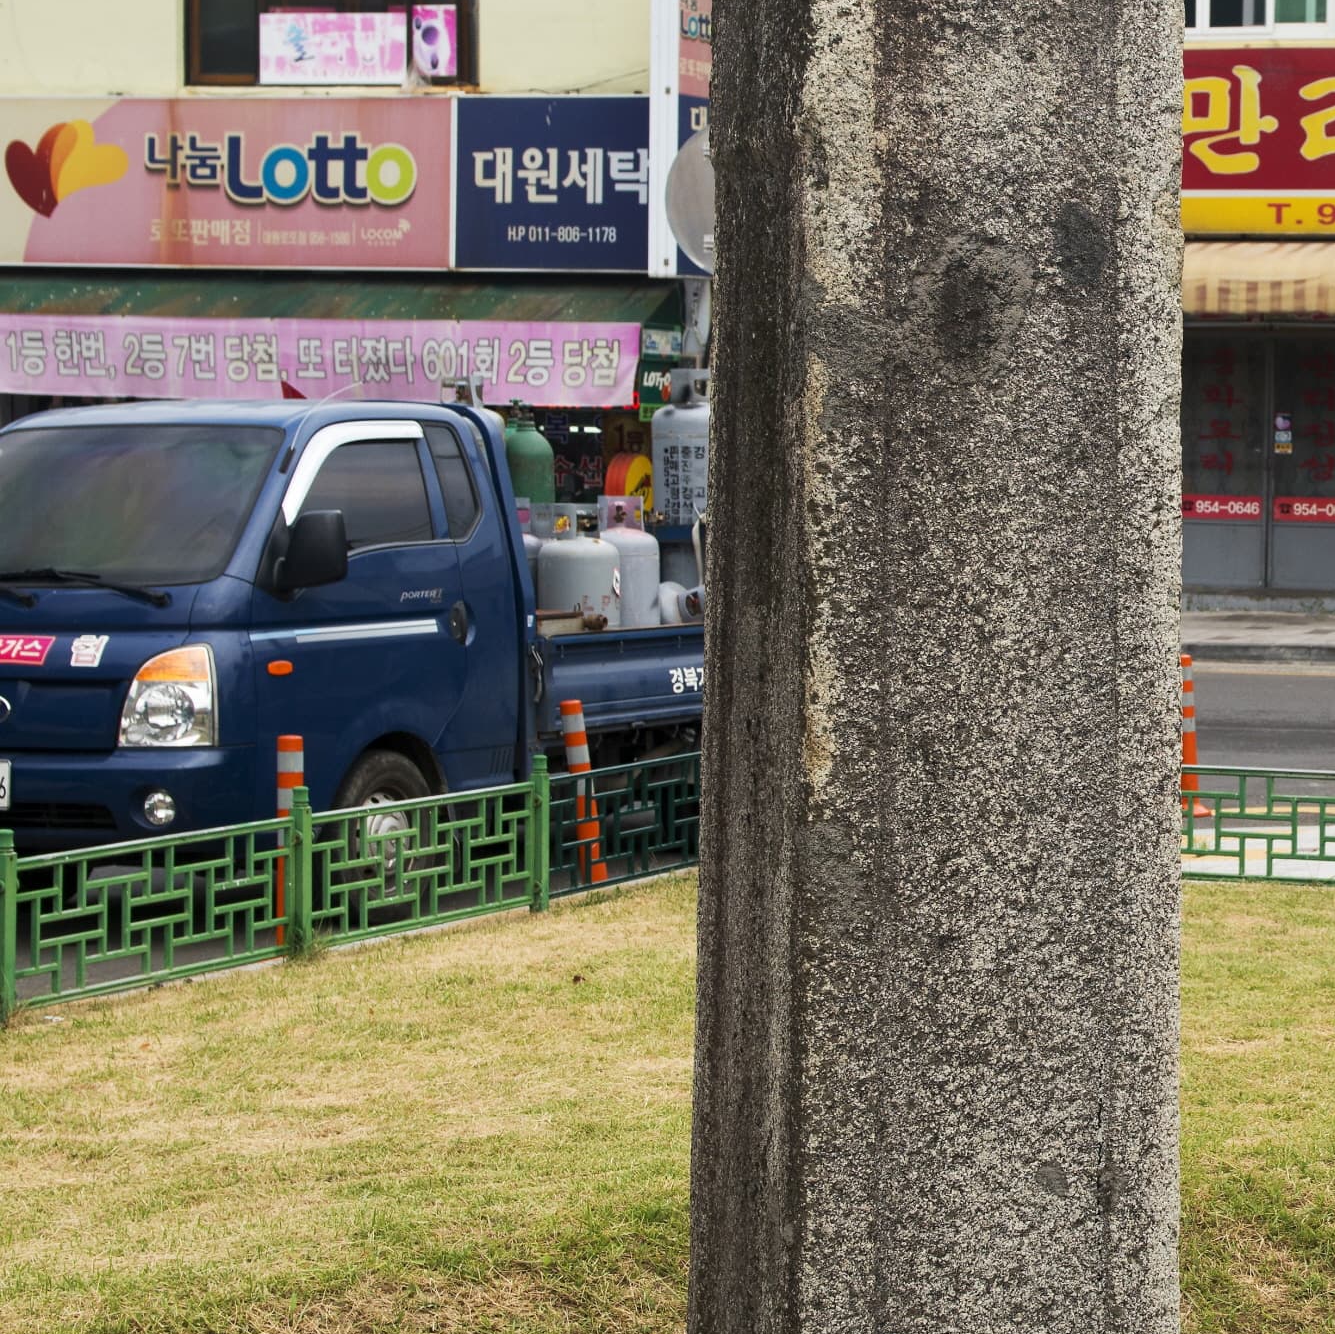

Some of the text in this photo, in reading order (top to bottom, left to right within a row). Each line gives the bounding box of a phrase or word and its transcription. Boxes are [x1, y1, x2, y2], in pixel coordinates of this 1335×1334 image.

[679, 10, 712, 42] Lott
[472, 147, 648, 205] 대원세탁
[528, 226, 617, 243] 011-806-1178
[5, 330, 47, 377] 1등
[53, 330, 117, 380] 한번,
[124, 333, 167, 380] 2등
[173, 334, 217, 381] 7번
[297, 338, 327, 380] 또
[332, 336, 415, 384] 터졌다
[422, 337, 500, 385] 601회
[506, 339, 554, 386] 2등
[562, 338, 621, 387] 당첨
[1195, 500, 1260, 515] 954-0646
[0, 639, 42, 658] 가스
